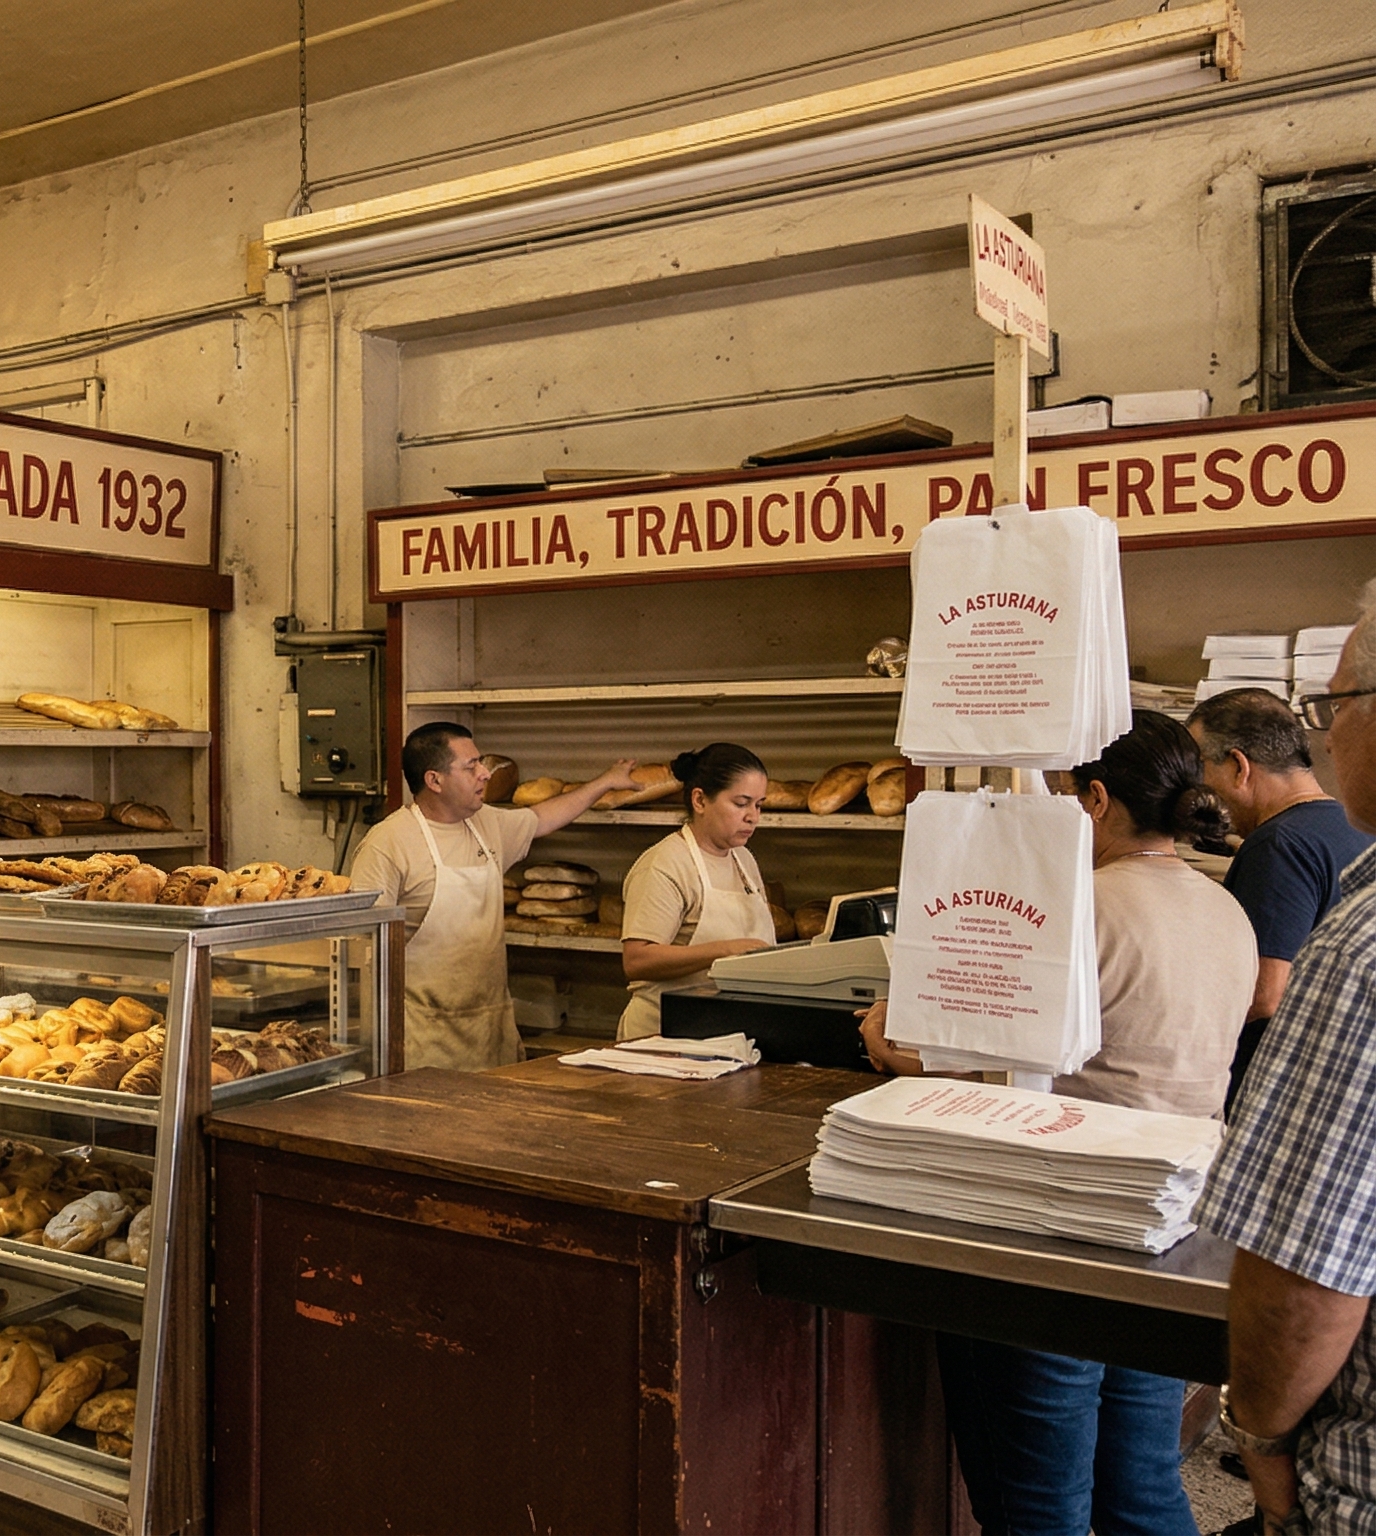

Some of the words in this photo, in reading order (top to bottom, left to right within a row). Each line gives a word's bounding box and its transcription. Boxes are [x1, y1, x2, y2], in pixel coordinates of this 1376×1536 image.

[976, 223, 991, 262] LA
[993, 228, 1046, 306] ASTURIANA
[98, 467, 187, 539] 1932
[401, 514, 590, 577] FAMILIA,
[606, 476, 905, 560] TRADICIÓN,
[1078, 438, 1347, 519] FRESCO
[938, 605, 962, 626] LA
[966, 592, 1059, 624] ASTURIANA
[924, 897, 948, 918] LA
[952, 889, 1047, 929] ASTURIANA
